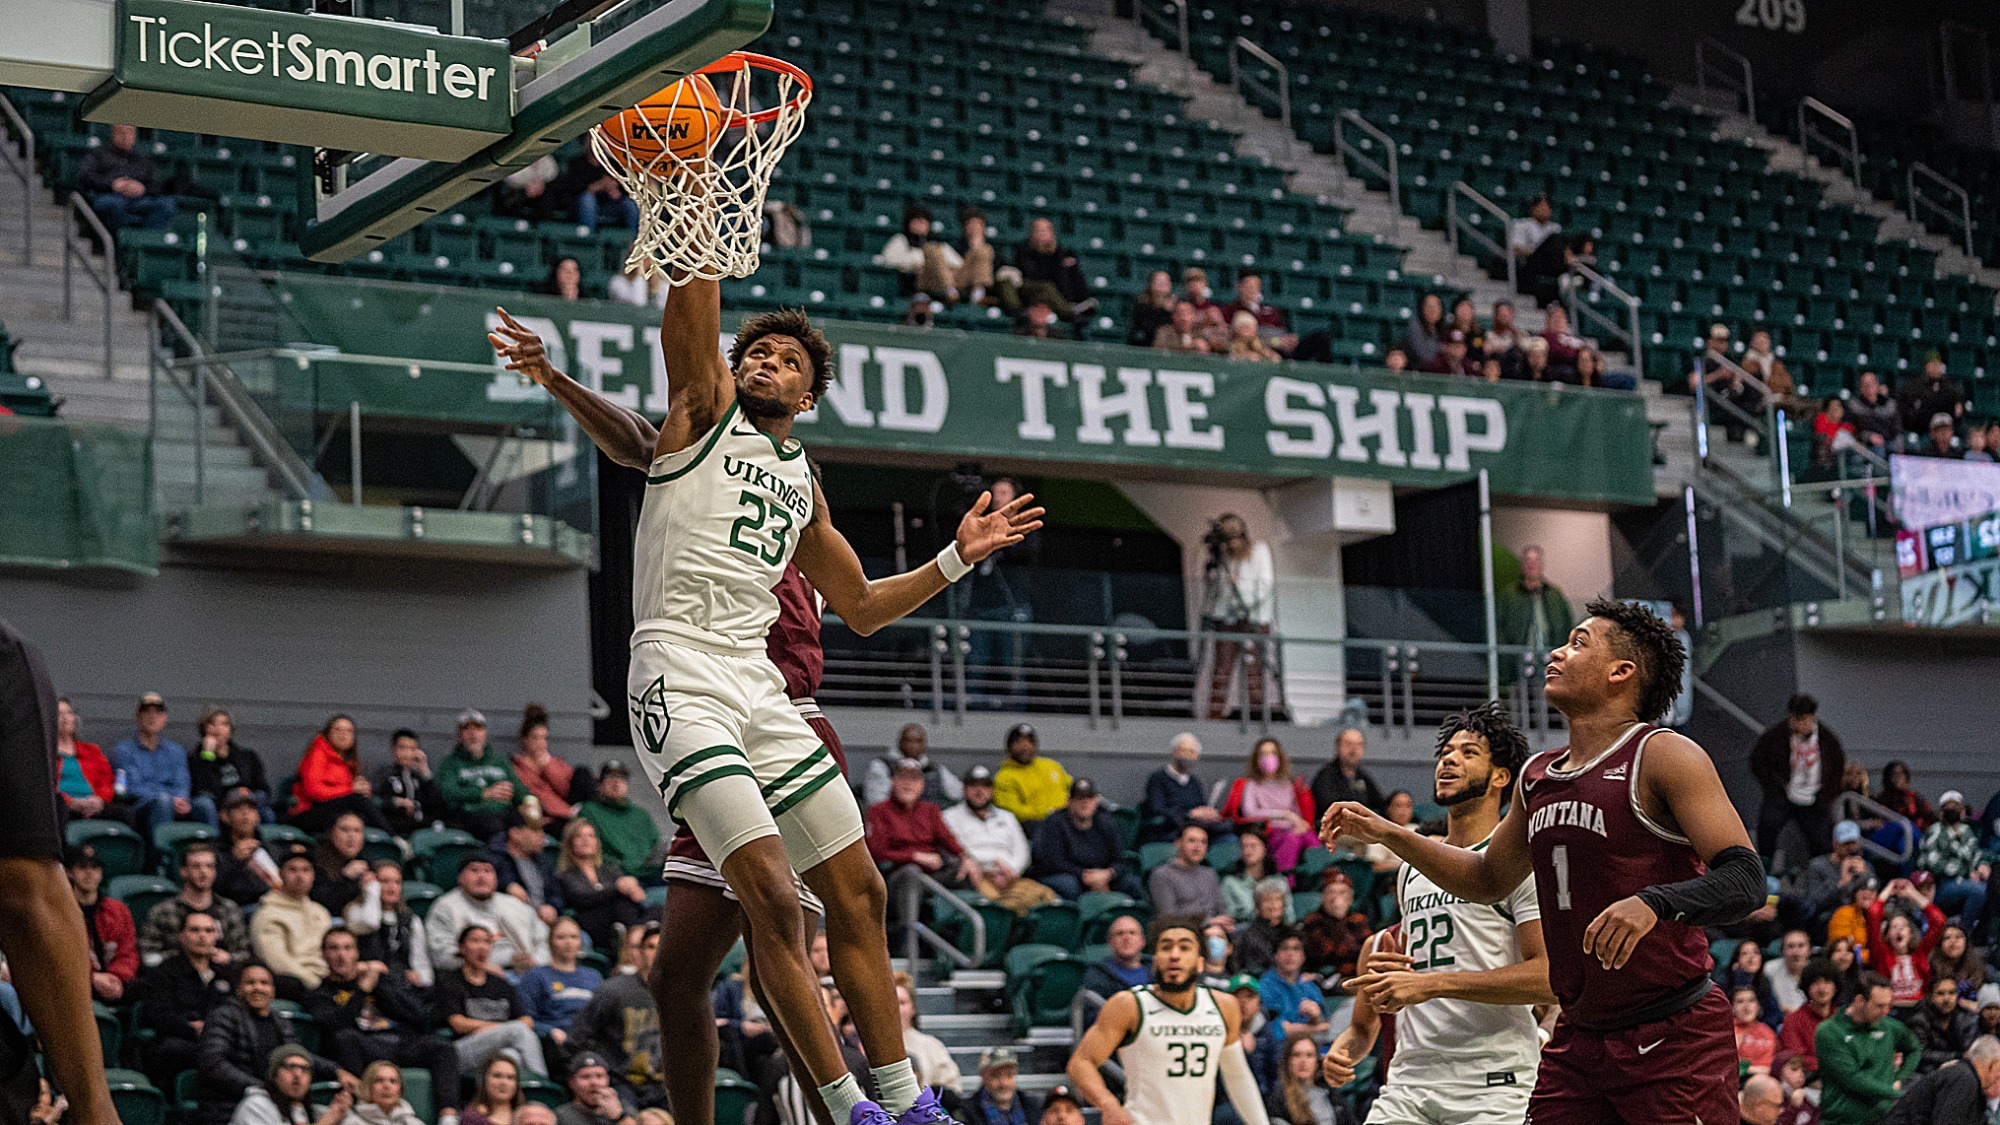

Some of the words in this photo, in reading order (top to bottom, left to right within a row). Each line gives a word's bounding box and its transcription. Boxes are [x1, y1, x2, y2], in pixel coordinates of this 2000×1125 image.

[130, 15, 495, 100] TicketSmarter
[995, 356, 1225, 451] THE
[1265, 376, 1507, 472] SHIP
[723, 454, 808, 519] VIKINGS
[729, 489, 793, 567] 23
[1527, 800, 1608, 844] MONTANA
[1551, 844, 1572, 910] 1
[1410, 913, 1455, 971] 22
[1149, 1024, 1223, 1037] VIKINGS
[1167, 1043, 1209, 1077] 33
